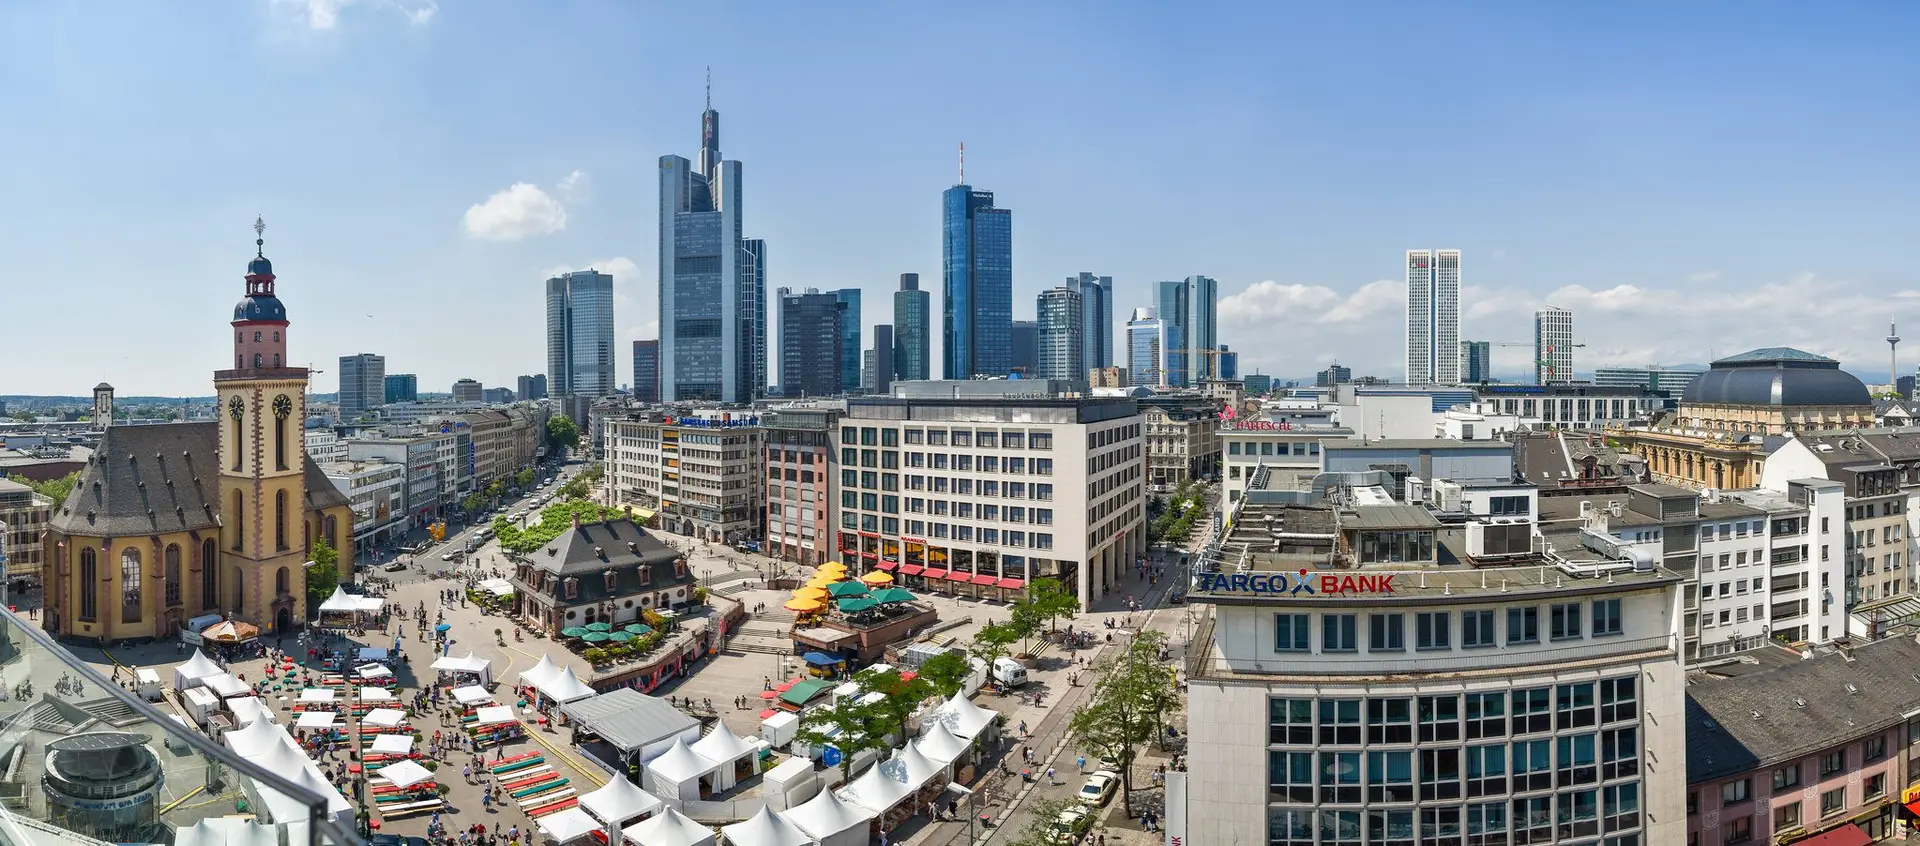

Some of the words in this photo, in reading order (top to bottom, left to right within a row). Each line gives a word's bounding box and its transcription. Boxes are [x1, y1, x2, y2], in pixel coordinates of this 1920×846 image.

[722, 416, 758, 428] SAMSUNG
[1199, 572, 1287, 593] TARGO
[1321, 574, 1395, 594] BANK
